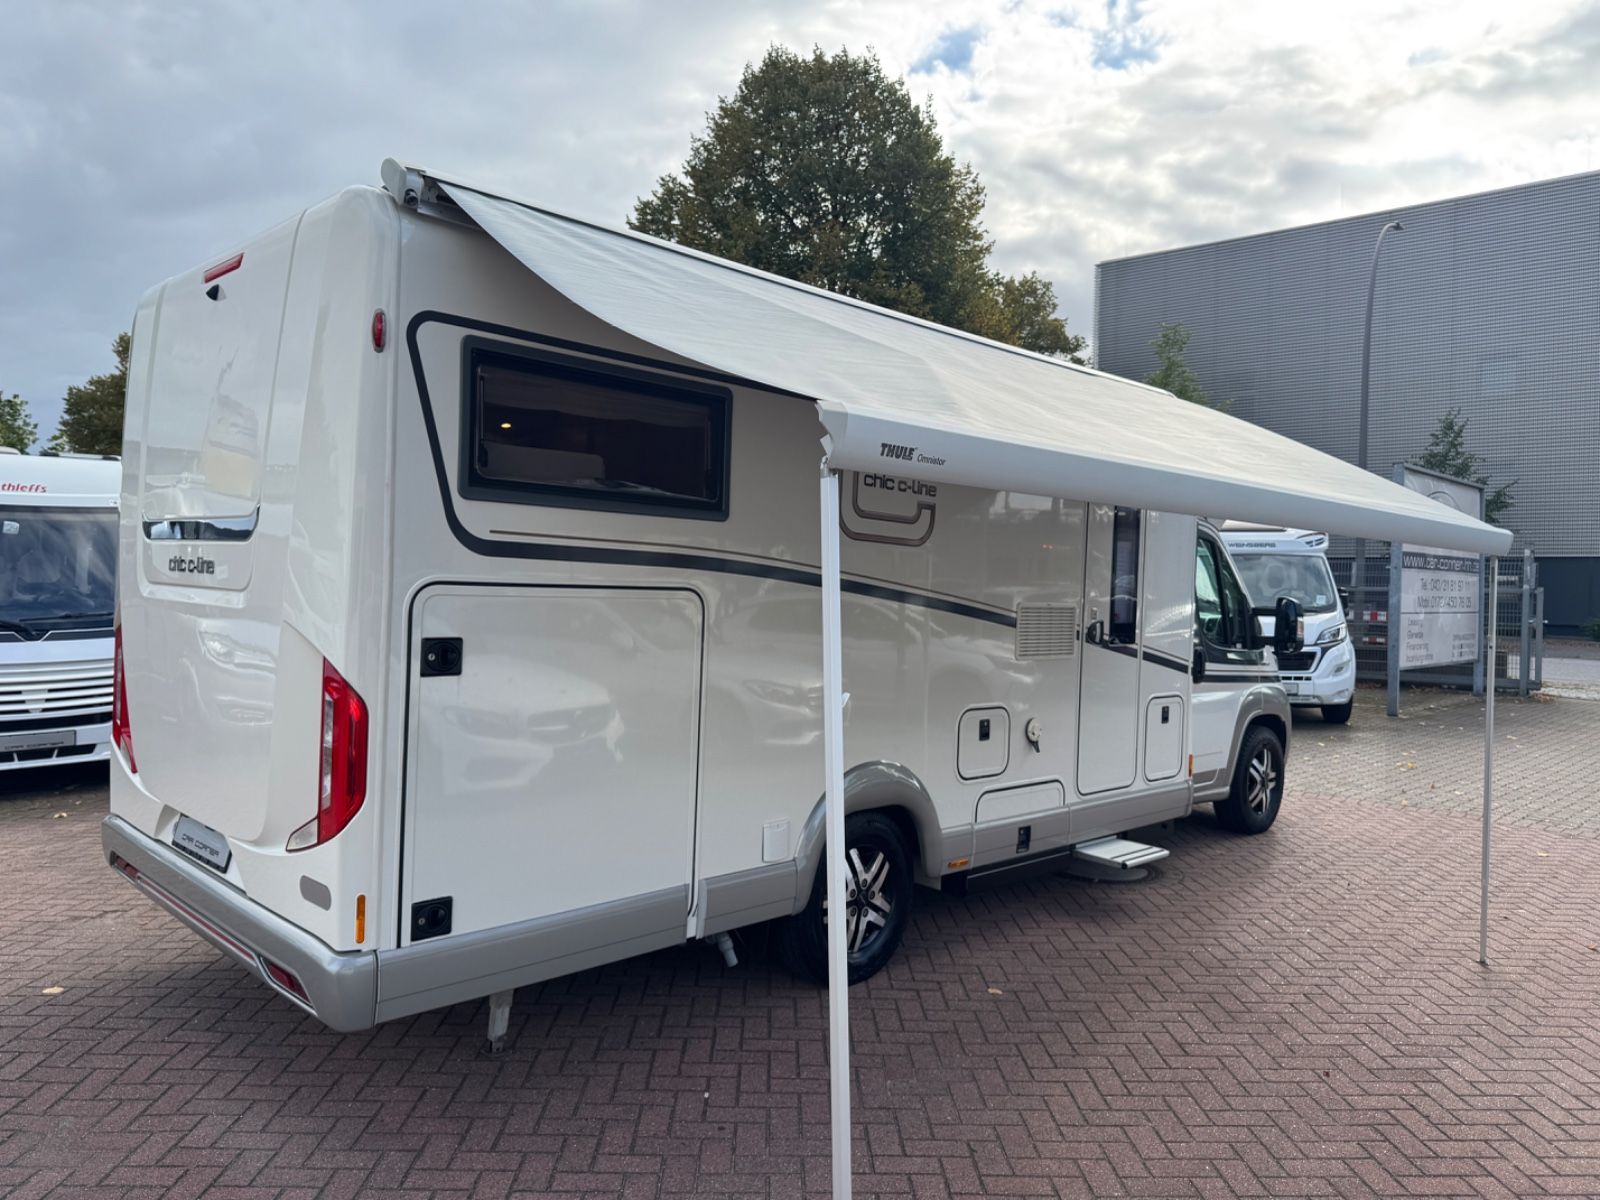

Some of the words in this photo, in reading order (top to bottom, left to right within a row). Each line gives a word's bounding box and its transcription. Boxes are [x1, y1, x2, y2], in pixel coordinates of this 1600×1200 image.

[880, 443, 915, 461] THULE
[917, 454, 947, 466] Omnistor
[864, 473, 895, 491] chic
[897, 480, 937, 497] c-line
[169, 556, 187, 573] chic
[187, 556, 215, 575] c-line
